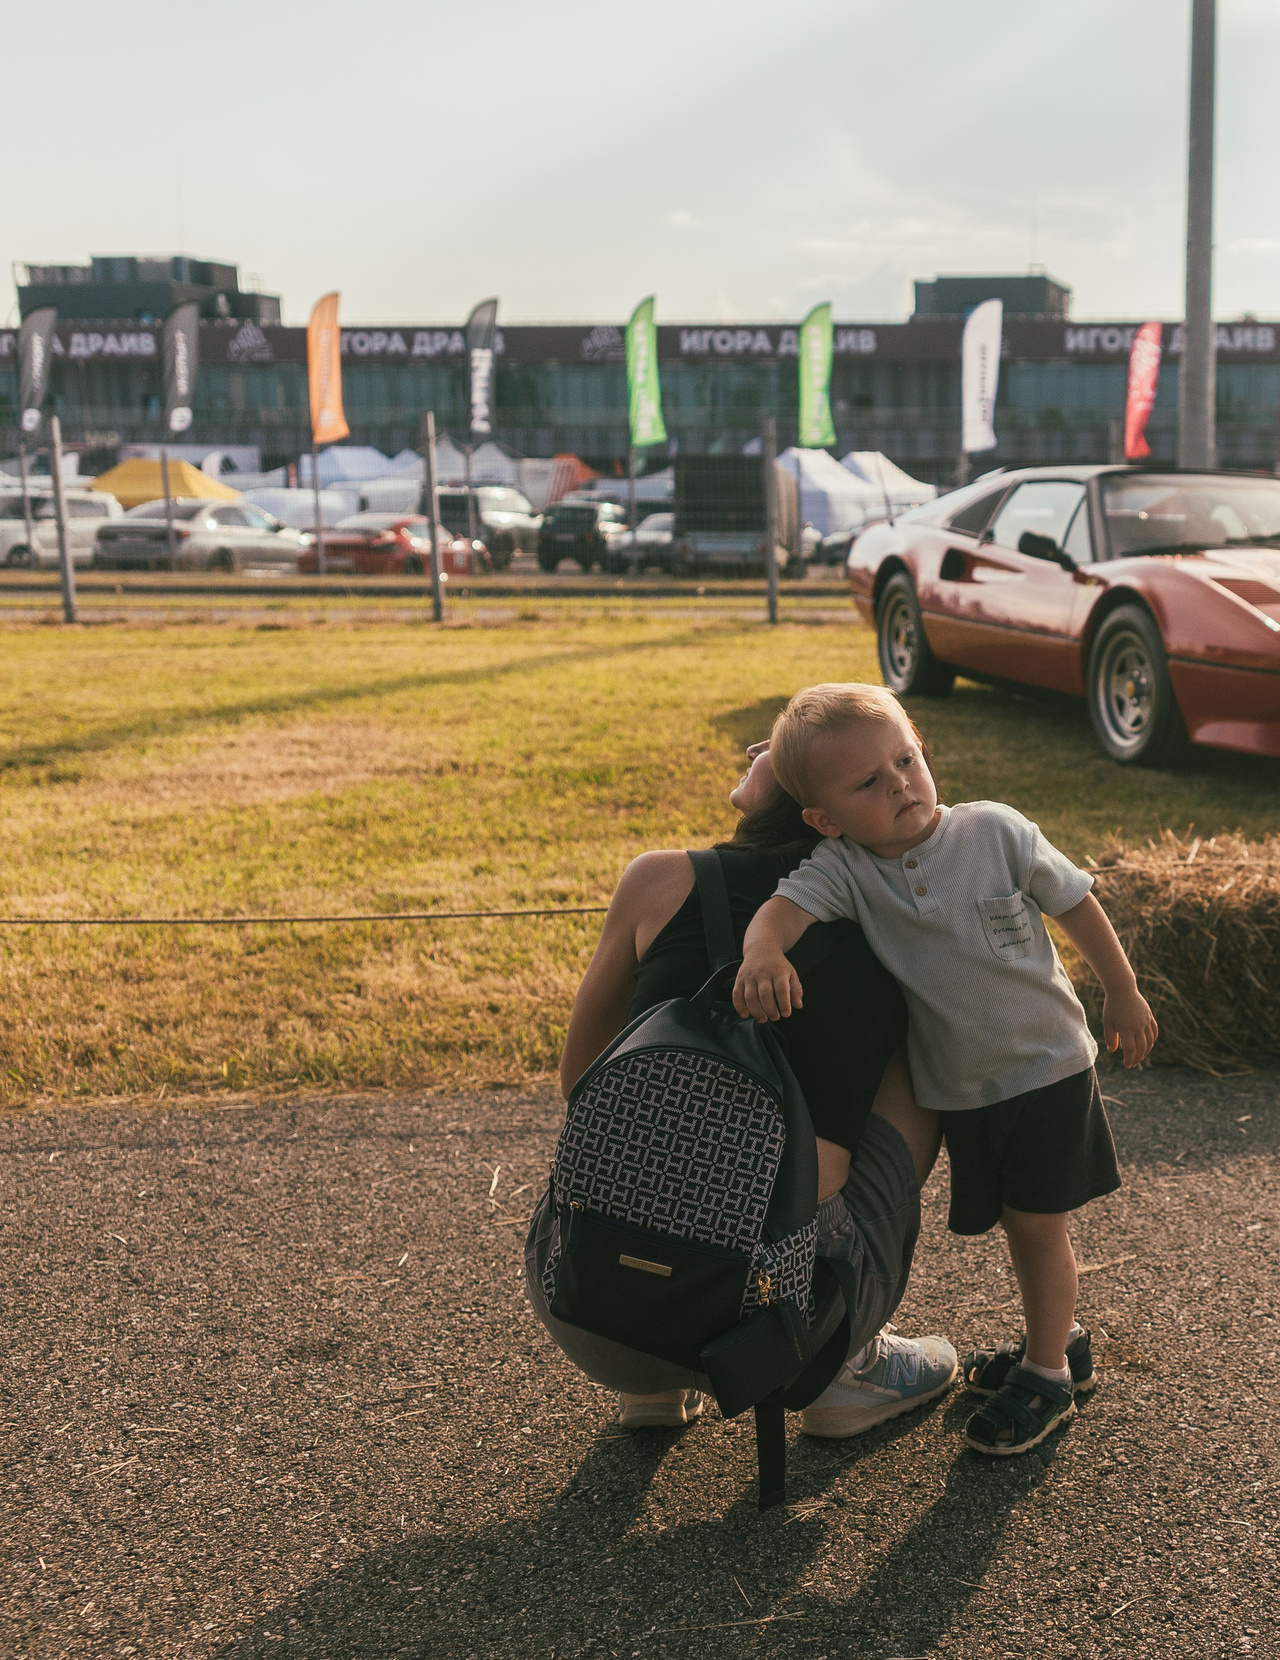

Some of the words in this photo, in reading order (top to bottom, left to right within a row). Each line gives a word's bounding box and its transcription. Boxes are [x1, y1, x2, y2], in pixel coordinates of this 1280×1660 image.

[679, 329, 774, 355] ИГОРА
[989, 914, 1009, 922] Keep
[888, 1352, 917, 1386] N
